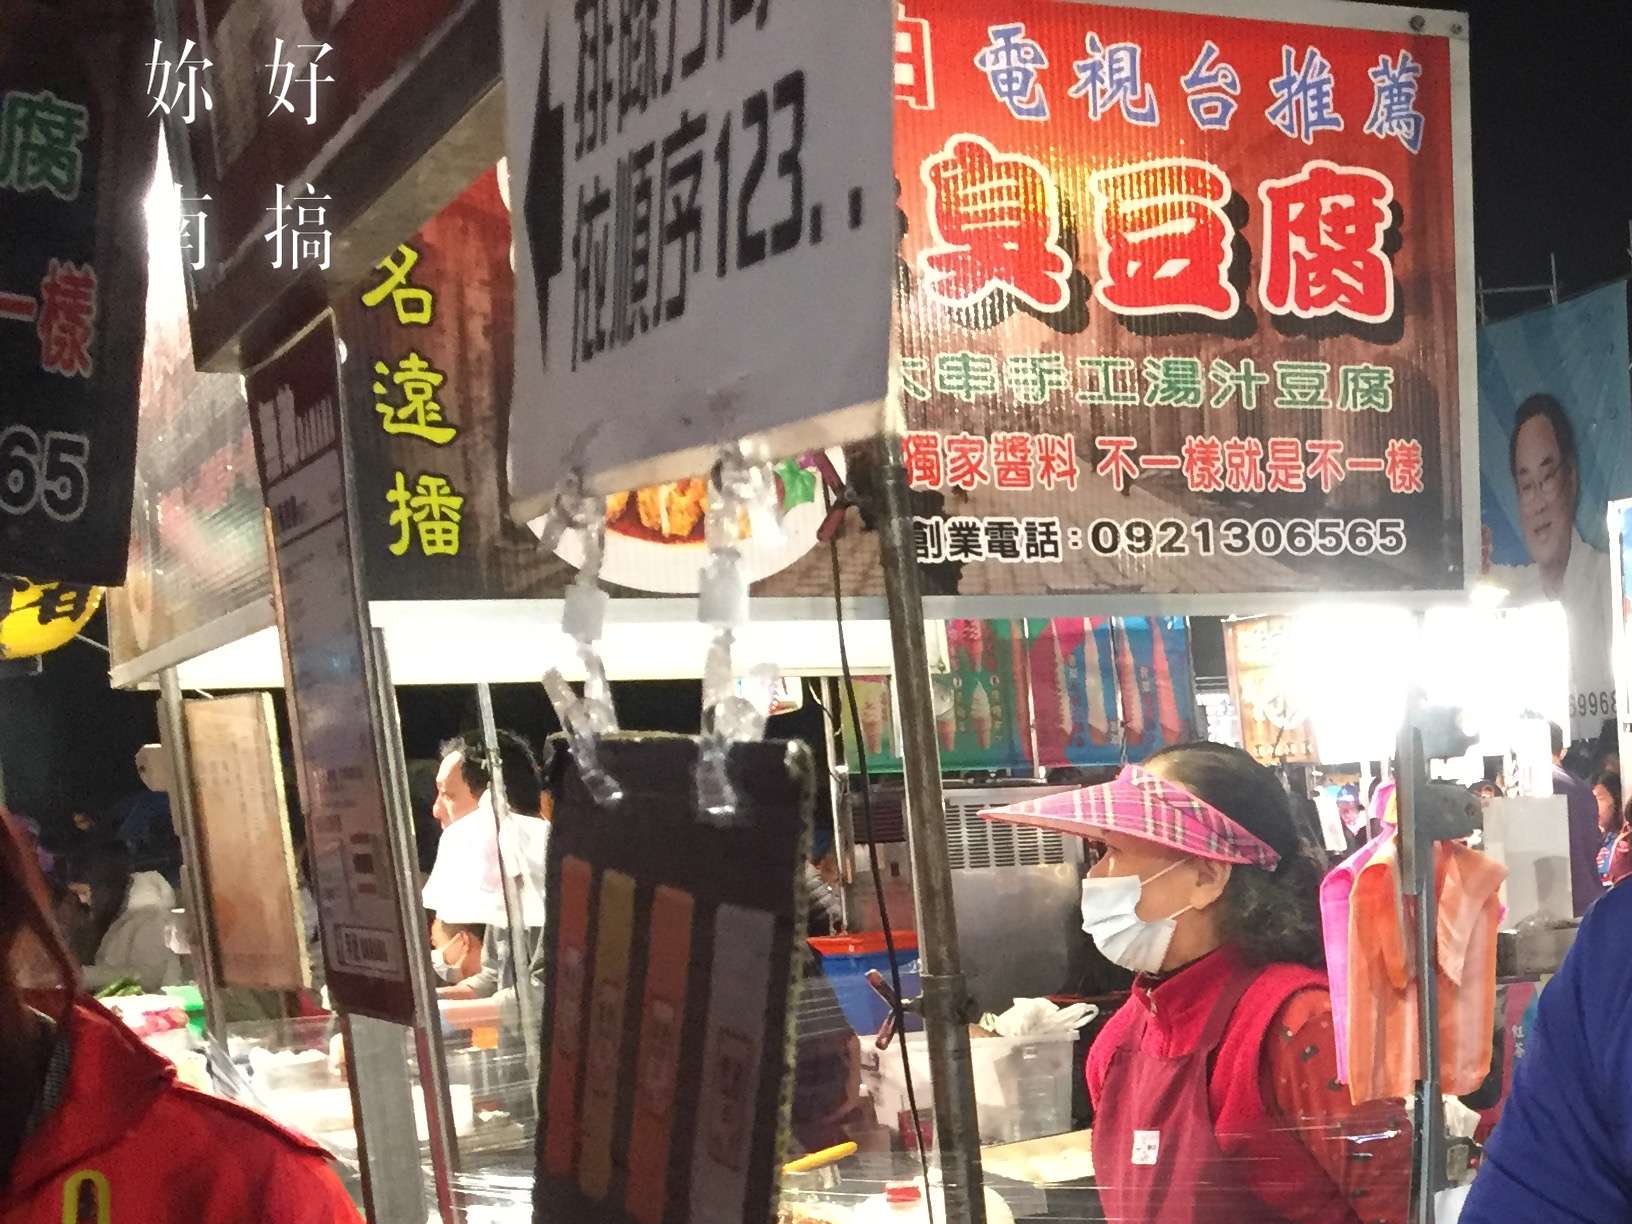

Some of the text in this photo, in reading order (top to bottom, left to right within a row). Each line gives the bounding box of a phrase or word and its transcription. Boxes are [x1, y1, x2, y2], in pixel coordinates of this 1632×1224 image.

[974, 22, 1427, 153] 電視台推薦
[918, 133, 1396, 325] 臭豆腐
[361, 243, 465, 557] 名遠播
[902, 432, 1425, 494] 獨家醬料 不一樣就是不一樣
